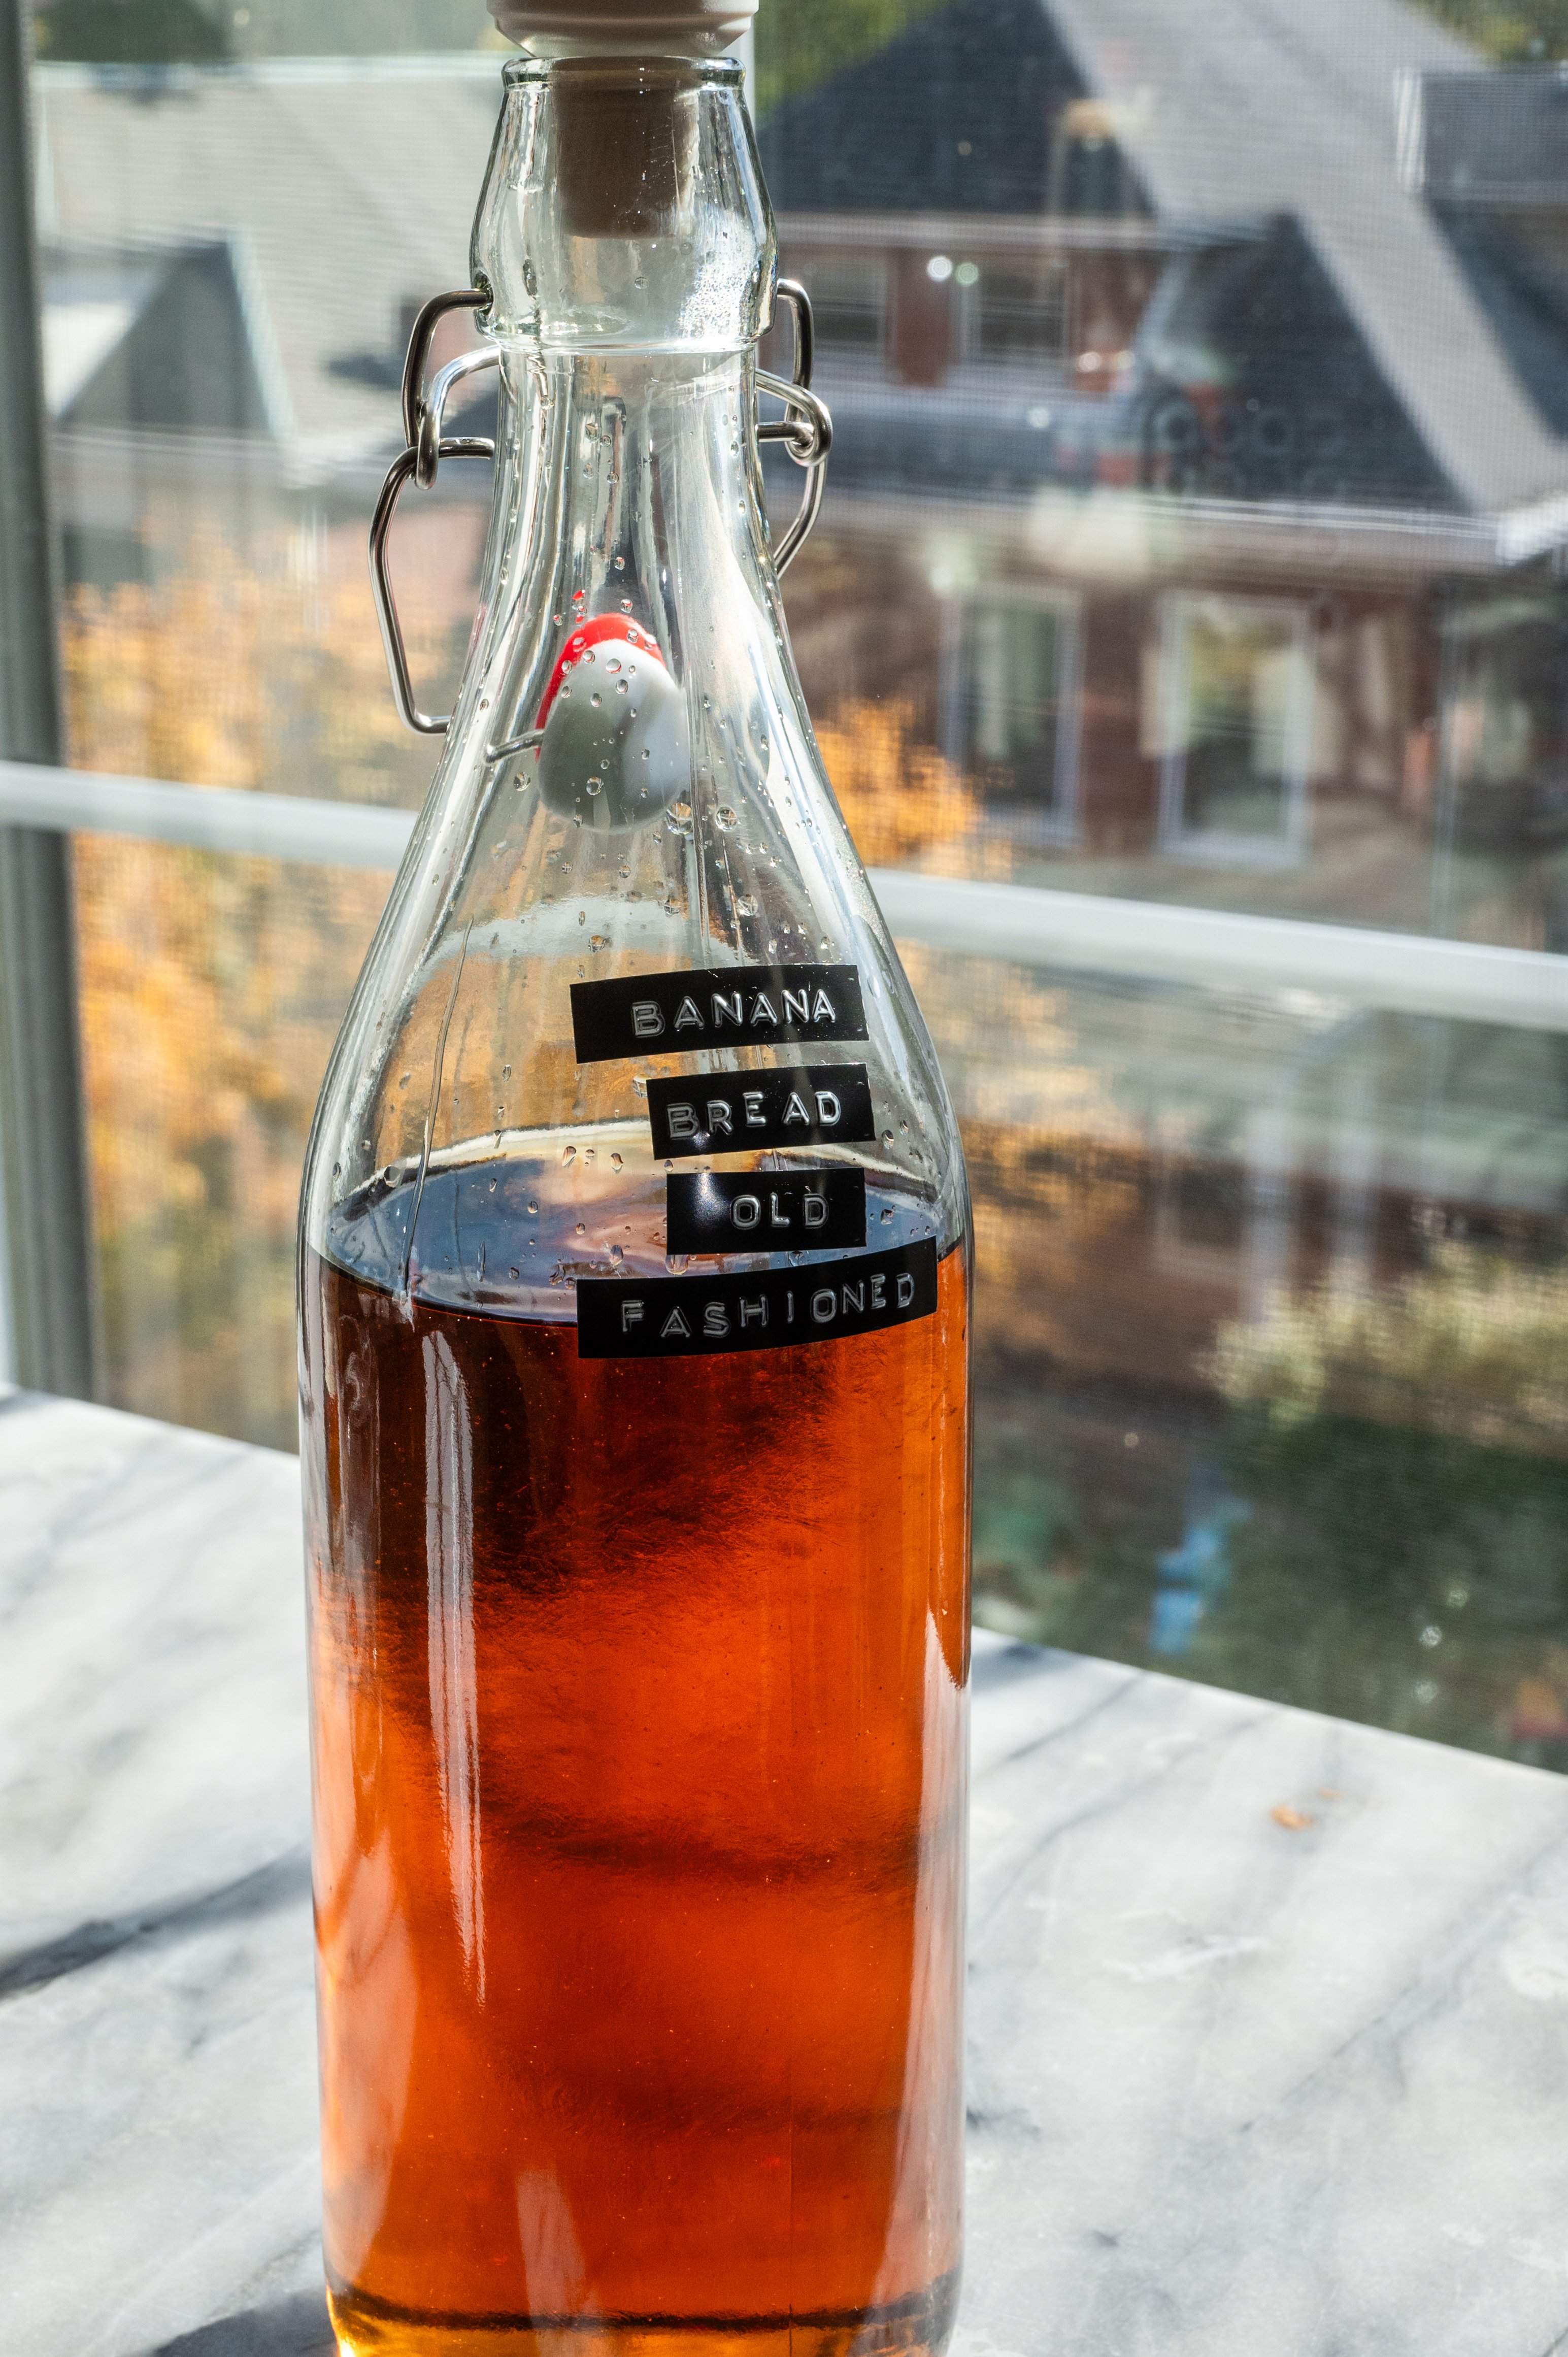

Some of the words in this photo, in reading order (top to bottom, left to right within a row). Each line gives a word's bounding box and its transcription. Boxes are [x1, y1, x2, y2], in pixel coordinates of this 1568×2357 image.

[631, 988, 837, 1037] BANANA
[666, 1091, 841, 1139] BREAD
[730, 1193, 829, 1230] OLD
[621, 1273, 915, 1338] FASHIONED
